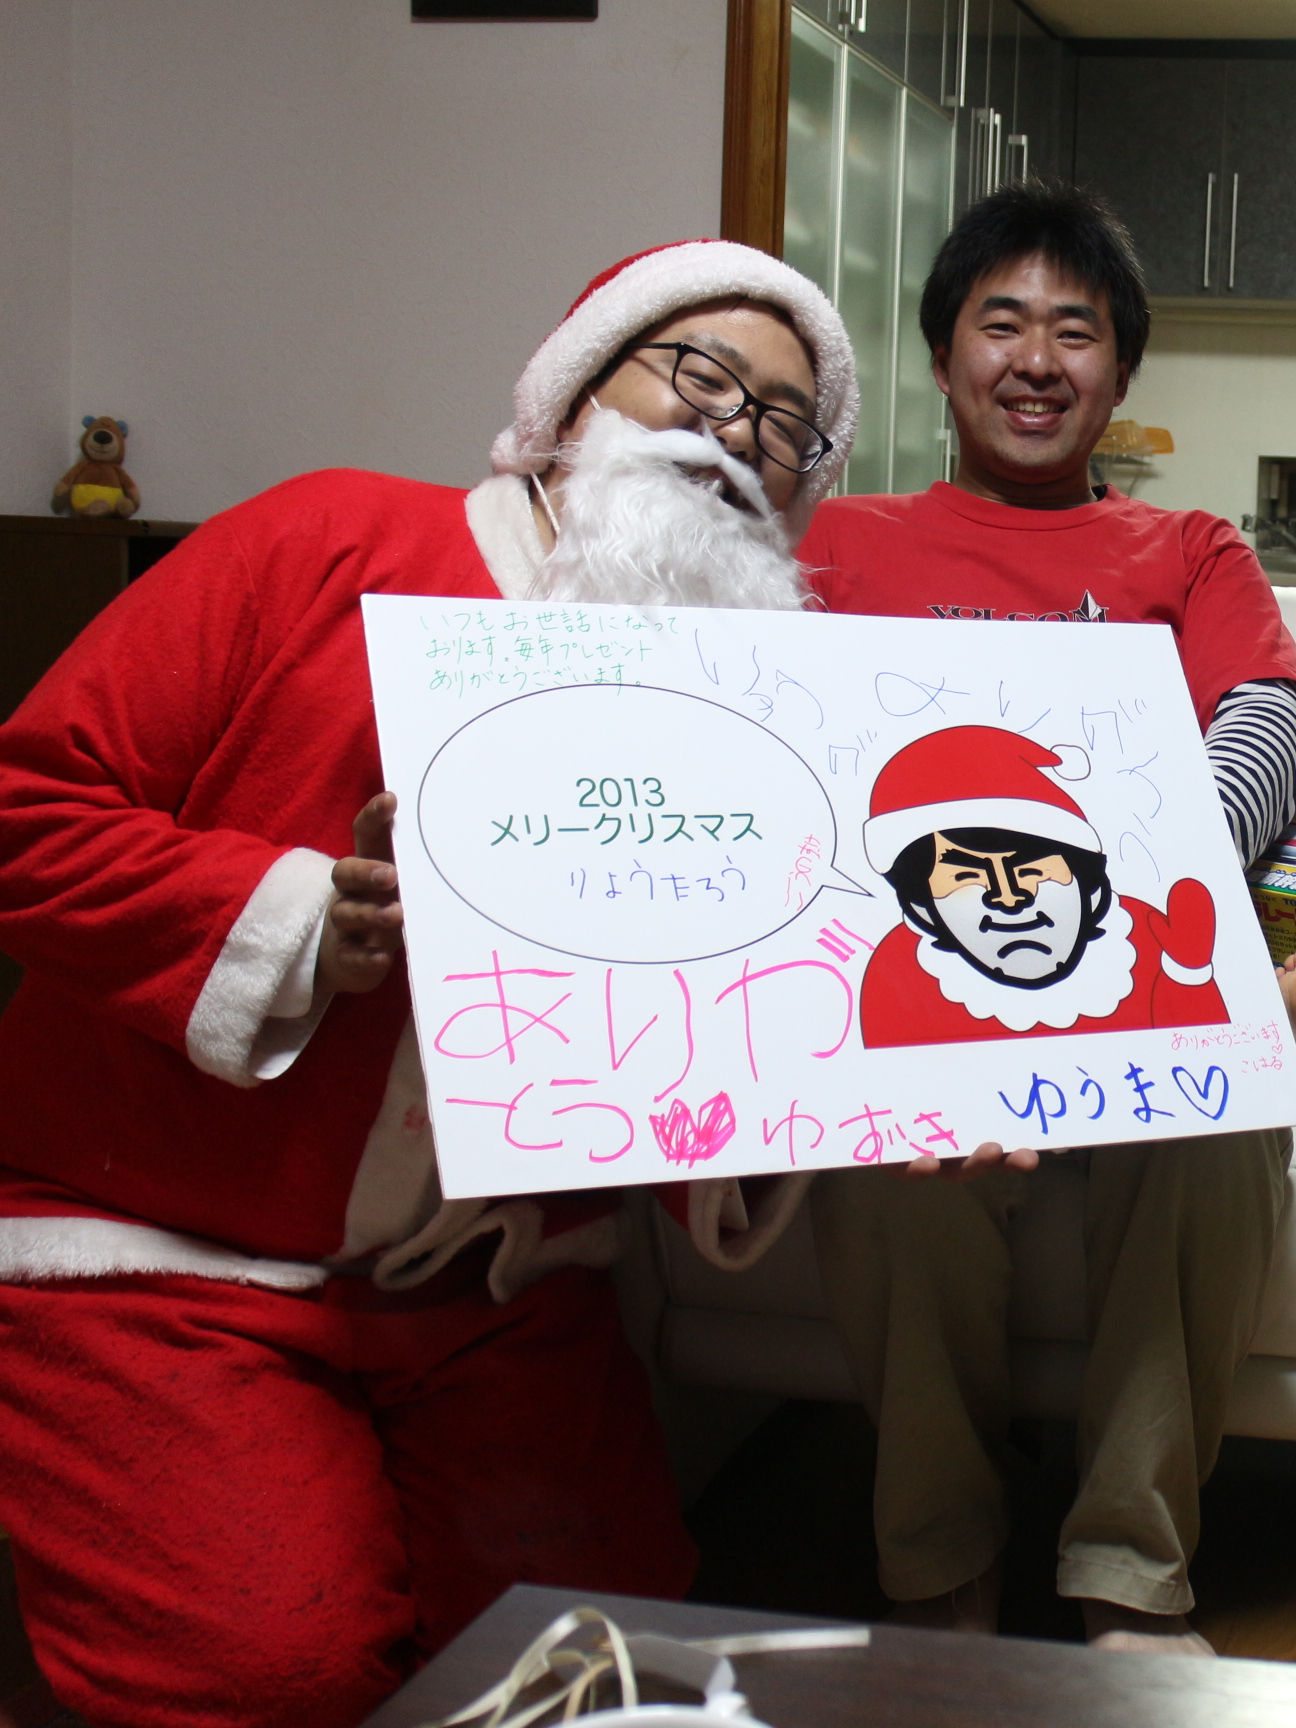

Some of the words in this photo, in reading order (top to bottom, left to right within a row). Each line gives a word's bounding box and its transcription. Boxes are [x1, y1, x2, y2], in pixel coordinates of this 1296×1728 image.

[420, 608, 679, 635] いつもお世話になって
[575, 777, 666, 808] 2013
[490, 813, 763, 847] メリークリスマス
[570, 855, 746, 902] りょうたろう
[1171, 1019, 1280, 1051] ありがとうございます
[1241, 1055, 1283, 1074] こはる
[997, 1060, 1177, 1136] ゆうま
